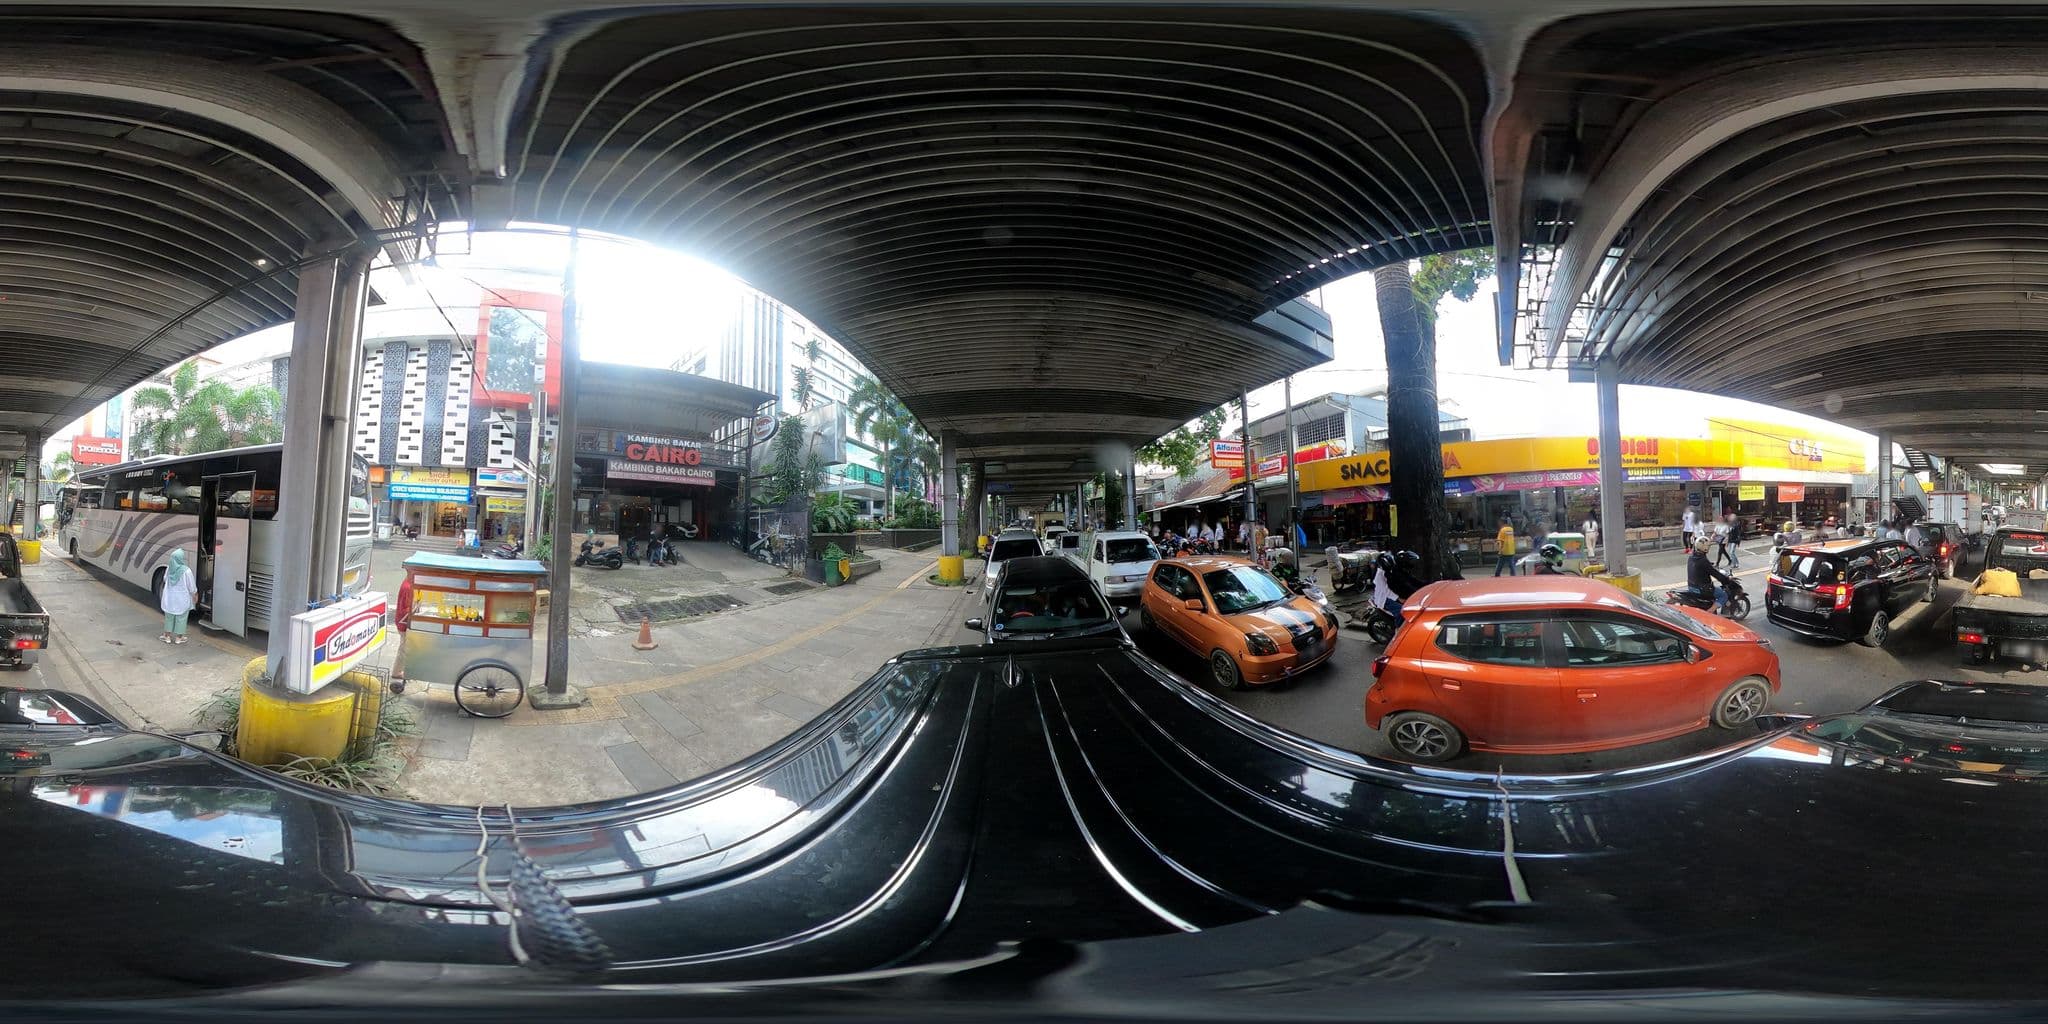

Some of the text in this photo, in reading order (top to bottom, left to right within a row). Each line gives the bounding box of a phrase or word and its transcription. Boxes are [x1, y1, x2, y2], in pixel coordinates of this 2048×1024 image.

[628, 434, 701, 449] KAMBING BAKAR
[1216, 444, 1244, 452] Alfamar
[626, 443, 702, 465] CAIRO
[611, 461, 713, 478] KAMBING BAKAR CAIRO
[1341, 459, 1389, 481] SNAC
[331, 619, 377, 656] Indomaret
